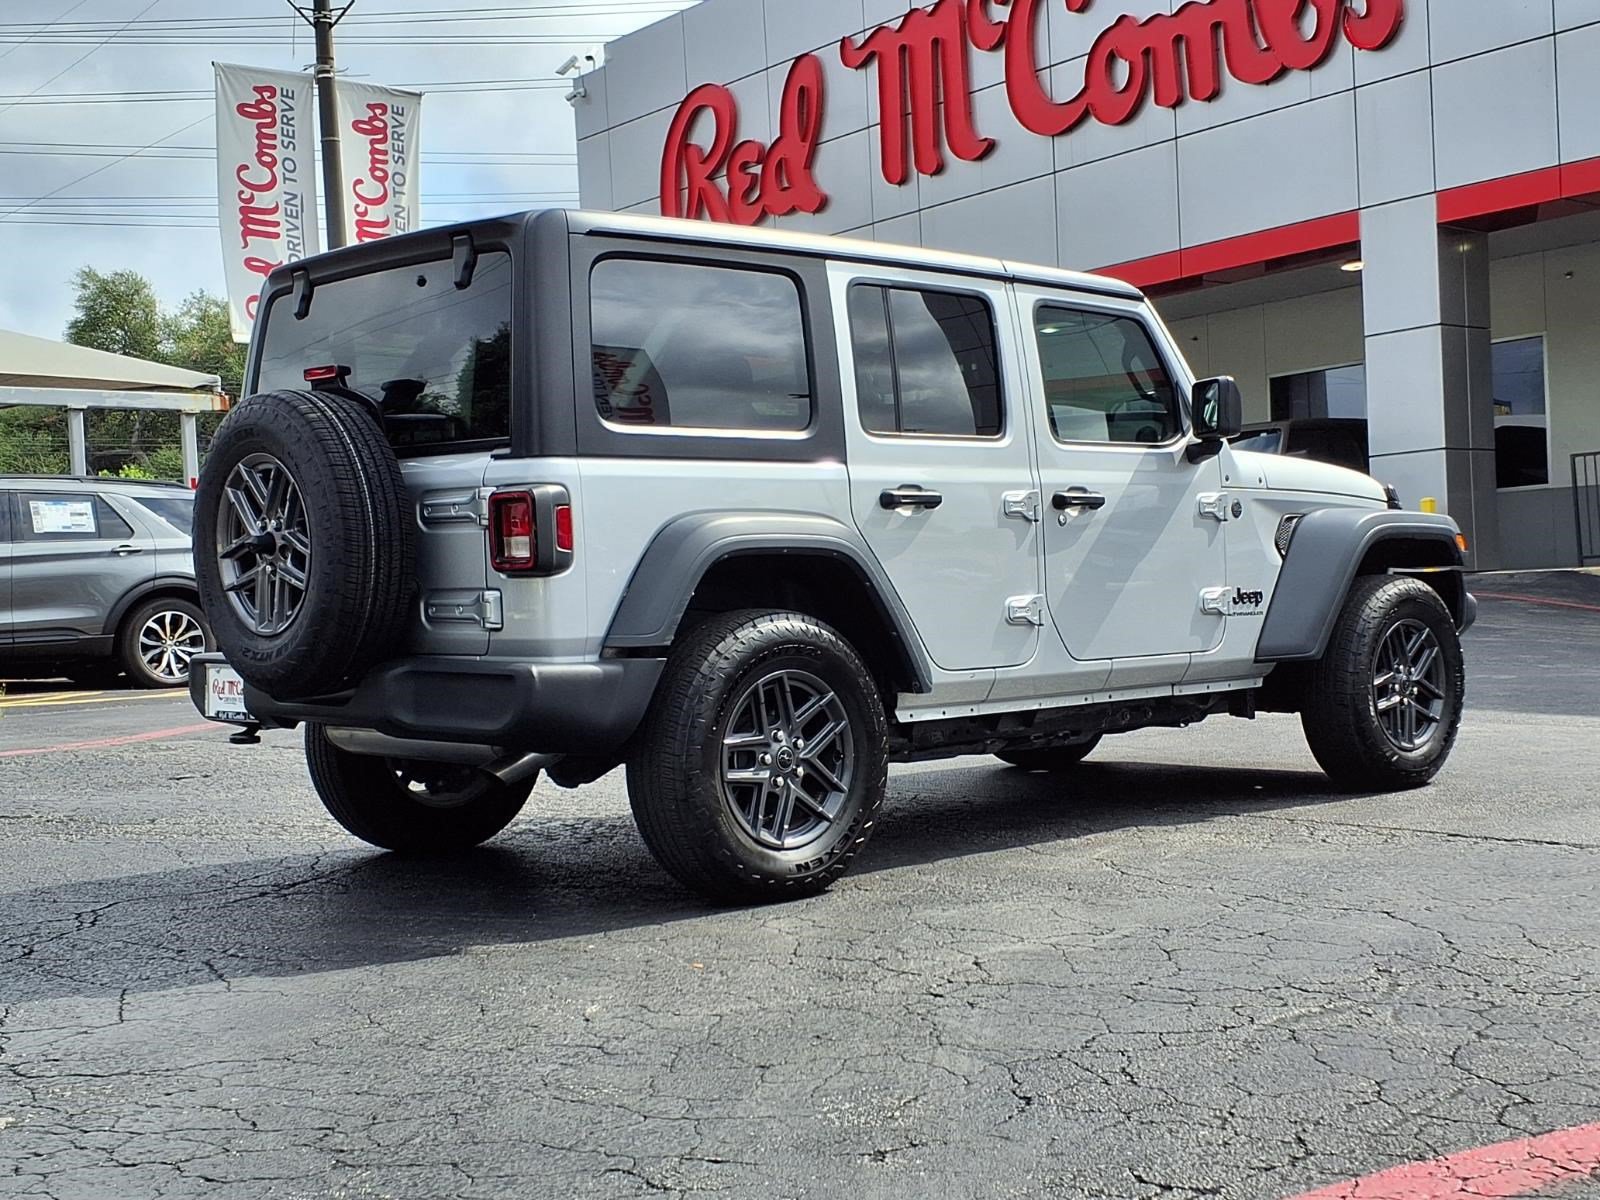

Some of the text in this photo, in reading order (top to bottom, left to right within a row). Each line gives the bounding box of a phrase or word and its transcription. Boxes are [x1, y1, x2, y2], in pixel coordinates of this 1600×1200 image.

[280, 86, 296, 152] SERVE
[391, 103, 405, 166] SERVE
[660, 53, 828, 227] Red
[236, 85, 281, 249] McCombs
[281, 157, 298, 185] TO
[392, 171, 406, 198] TO
[1232, 587, 1263, 607] Jeep
